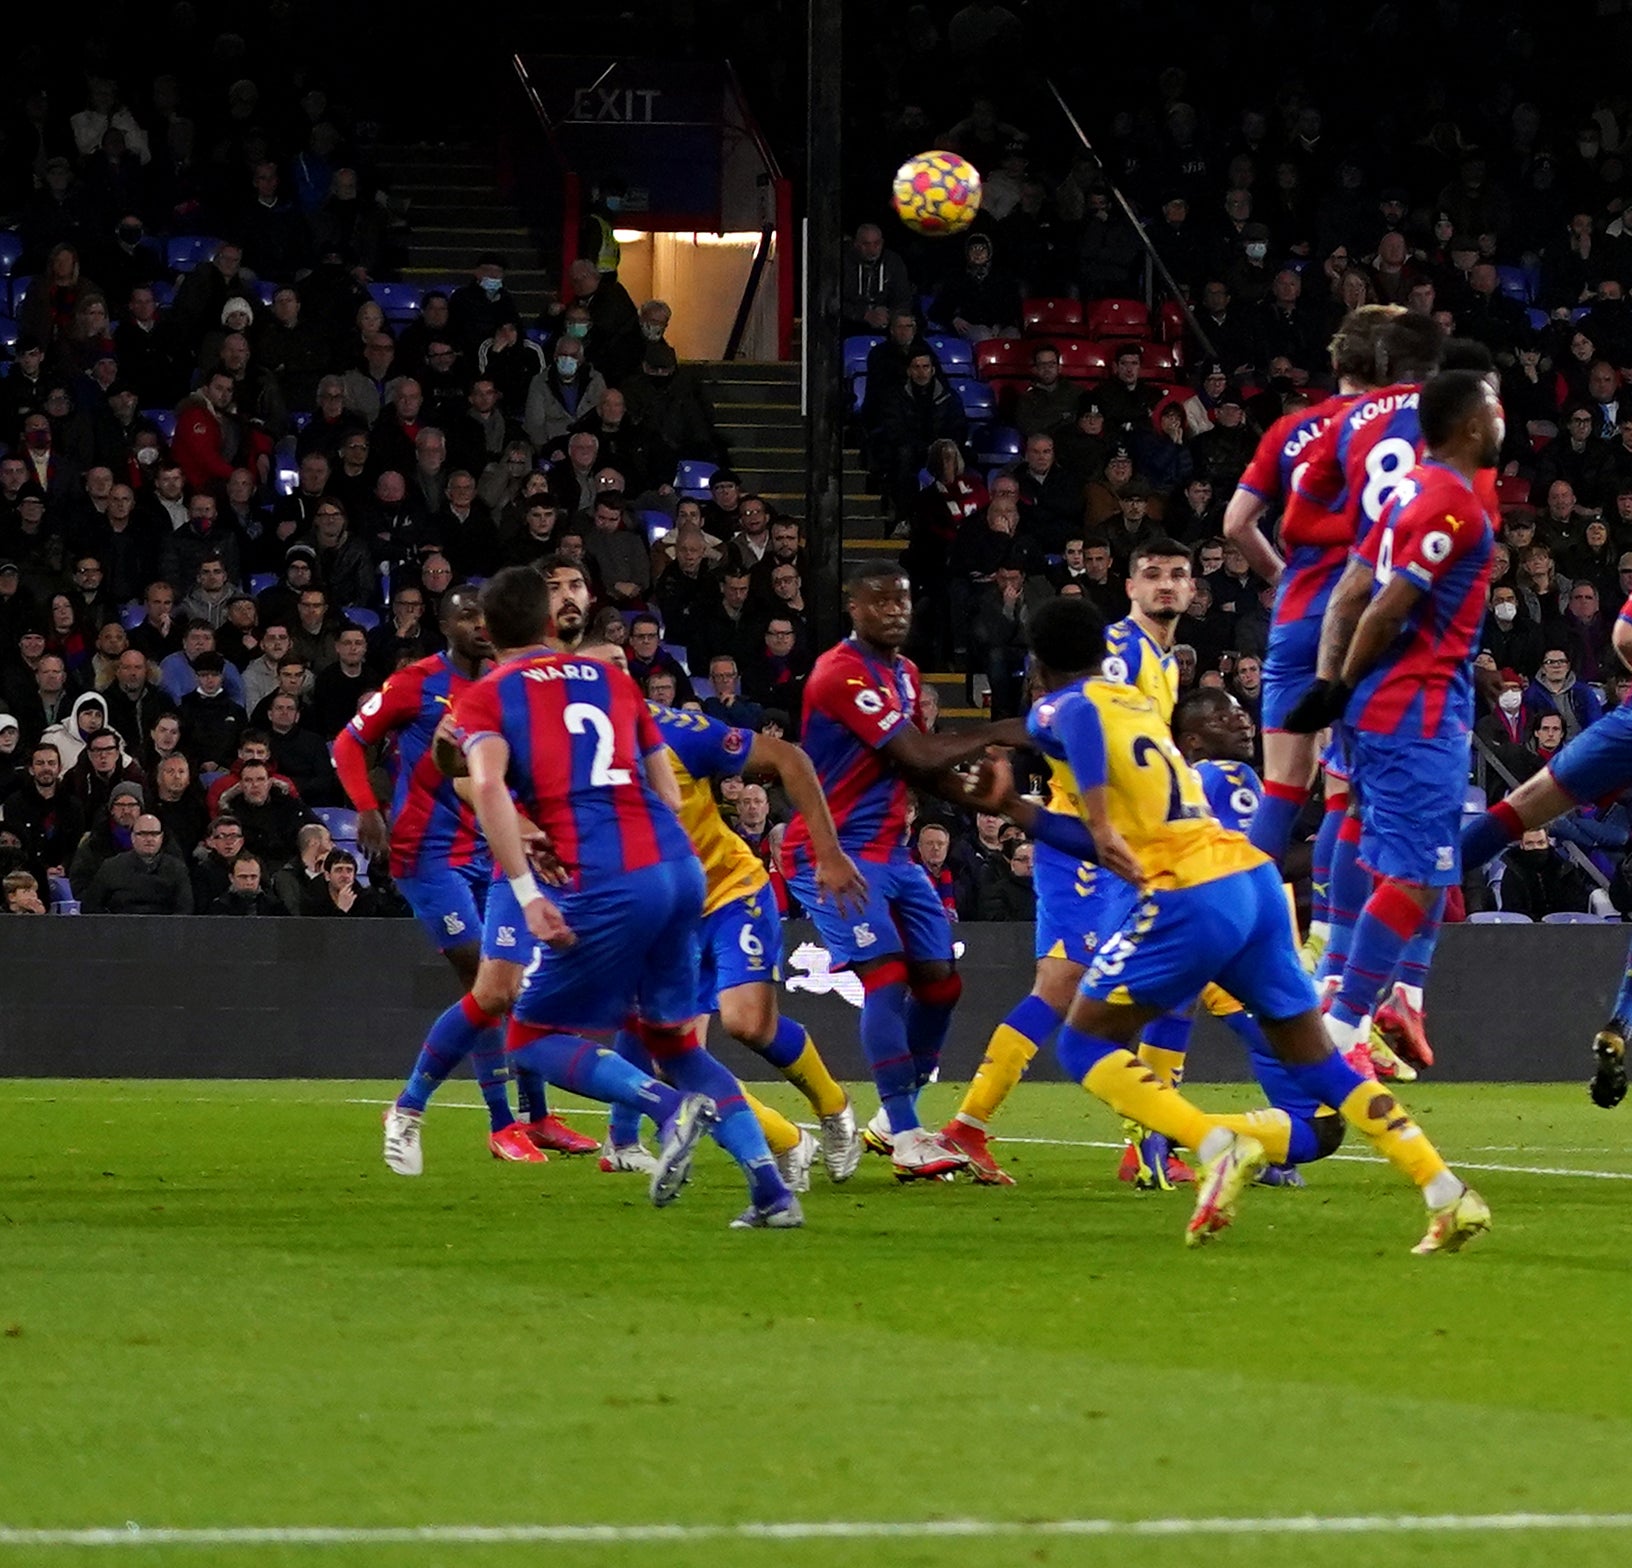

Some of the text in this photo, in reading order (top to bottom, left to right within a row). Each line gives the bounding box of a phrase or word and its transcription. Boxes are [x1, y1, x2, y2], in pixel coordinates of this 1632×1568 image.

[573, 88, 662, 122] EXIT
[1284, 417, 1332, 458] GAL
[1361, 437, 1416, 523] 8
[520, 663, 600, 683] WARD
[562, 702, 633, 787] 2
[739, 923, 764, 956] 6
